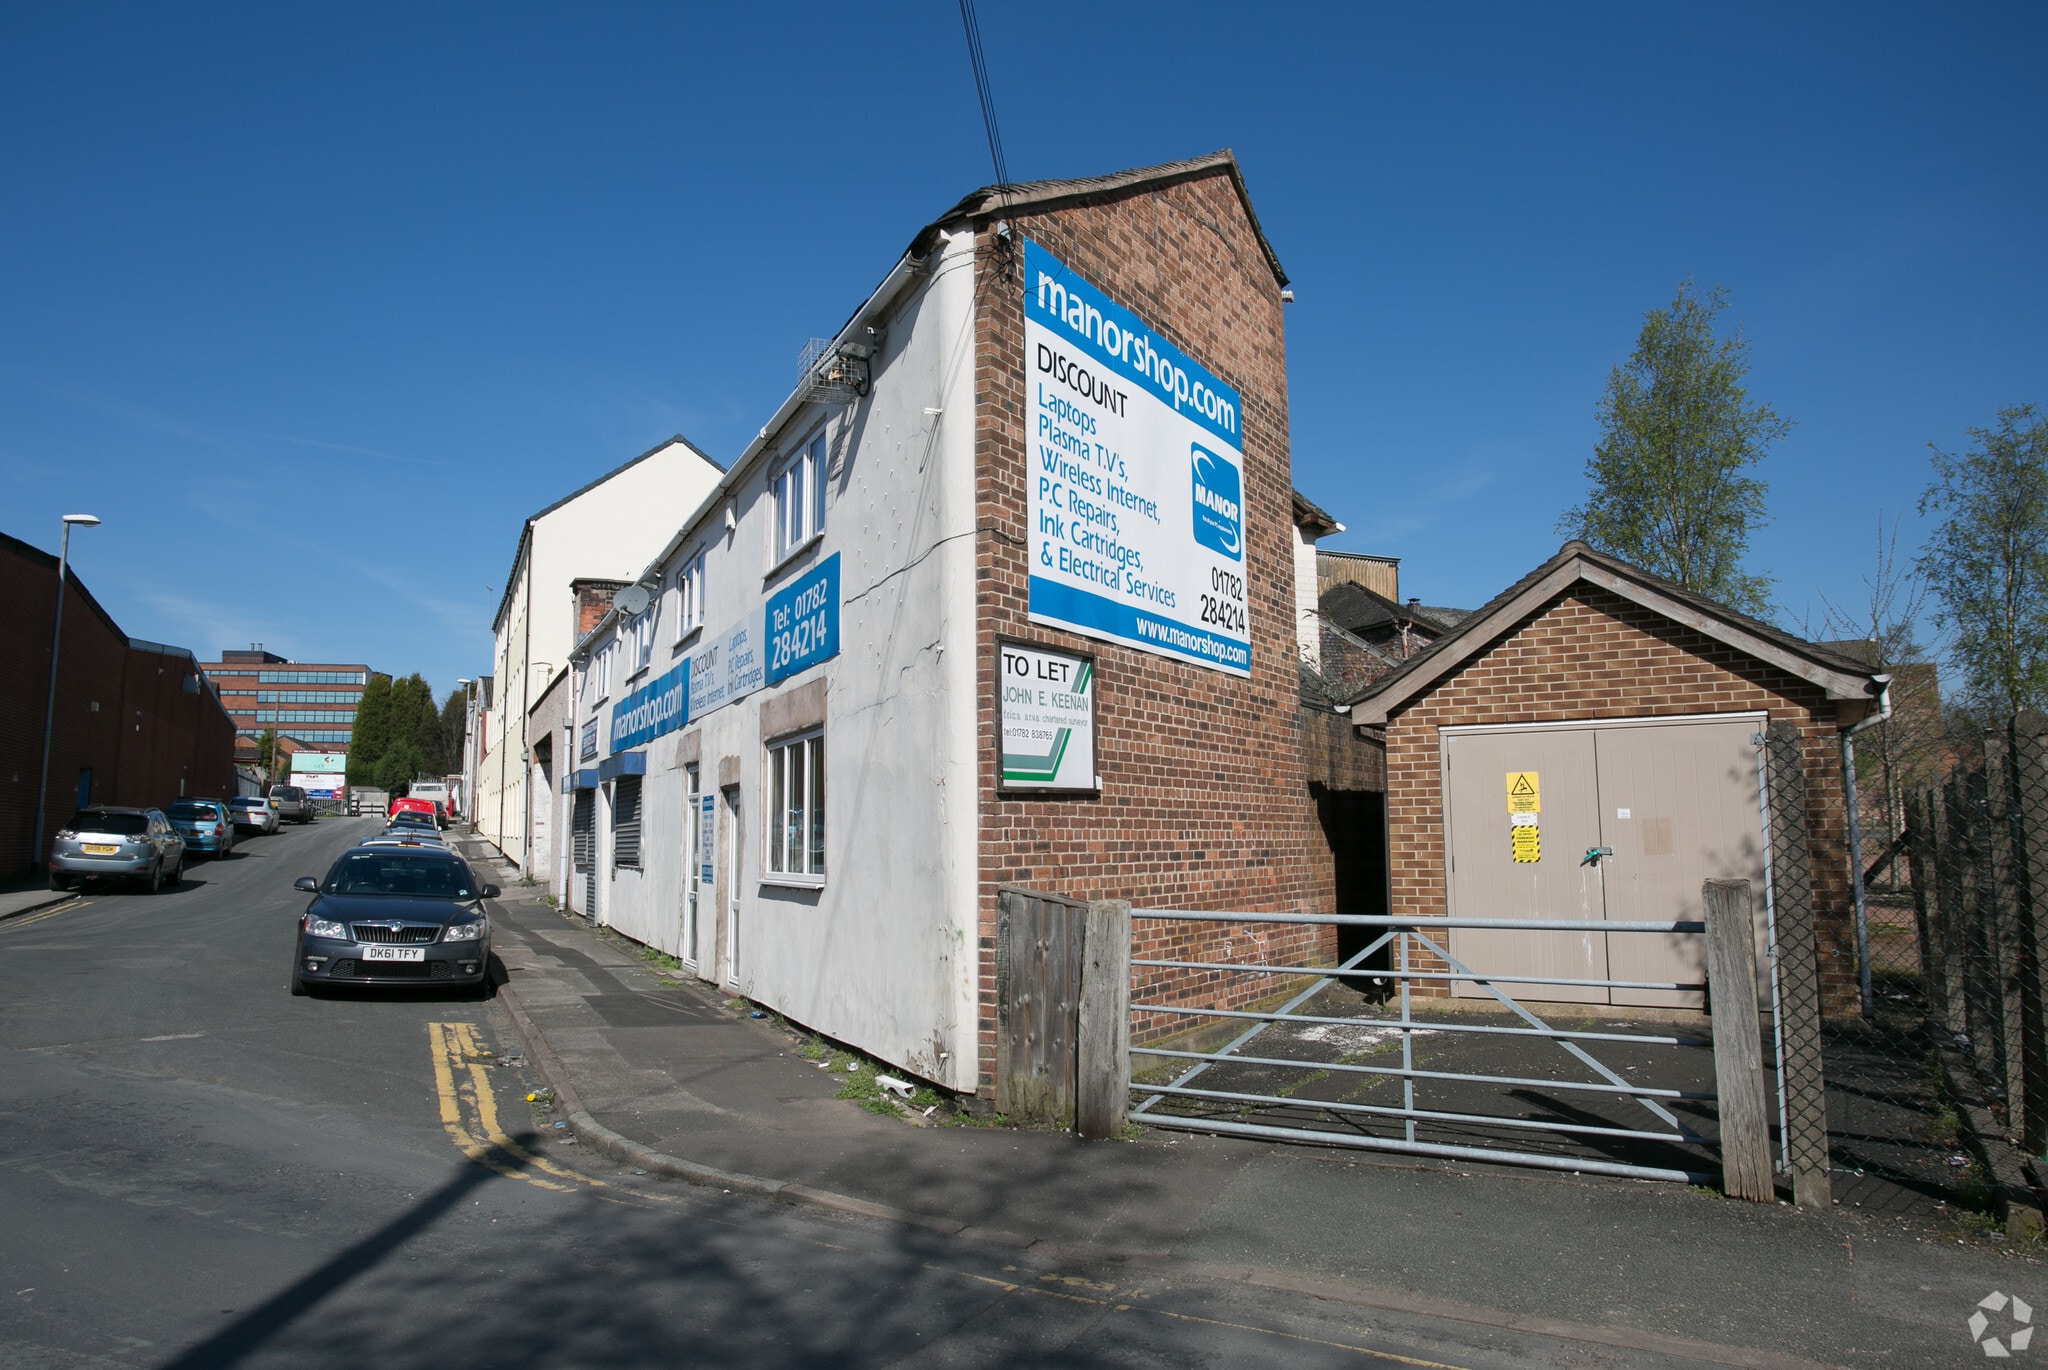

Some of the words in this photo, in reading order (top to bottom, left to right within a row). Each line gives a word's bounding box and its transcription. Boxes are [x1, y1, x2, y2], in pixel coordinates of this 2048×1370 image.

[1038, 270, 1235, 434] manorshop.com
[1038, 343, 1128, 418] DISCOUNT
[1039, 382, 1097, 437] Laptops
[1039, 413, 1090, 461] Plasma
[1094, 443, 1129, 483] T.V's,
[1039, 444, 1102, 496] Wireless
[1107, 477, 1161, 525] Internet,
[1039, 476, 1063, 508] P.C
[1069, 489, 1120, 537] Repairs,
[1195, 482, 1239, 523] MANOR
[1039, 508, 1065, 540] Ink
[1071, 521, 1144, 573] Cartridges,
[1040, 541, 1054, 568] &
[1059, 546, 1120, 590] Electrical
[1126, 572, 1176, 608] Services
[1212, 566, 1243, 602] 01782
[772, 604, 790, 633] Tel:
[794, 578, 828, 620] 01782
[1201, 594, 1246, 635] 284214
[690, 646, 718, 679] DISCOUNT
[772, 609, 827, 671] 284214
[1136, 617, 1247, 665] www.manorshop.com
[1003, 653, 1029, 677] TO
[1037, 659, 1069, 683] LET
[613, 682, 683, 742] manorshop.com
[690, 695, 706, 713] Wireless
[1003, 686, 1032, 704] JOHN
[1039, 690, 1047, 706] E.
[1052, 692, 1089, 712] KEENAN
[1043, 714, 1067, 725] chartered
[1069, 719, 1088, 728] surveyor
[1031, 730, 1053, 741] 838765
[370, 948, 395, 958] DK61
[397, 949, 418, 959] TFY
